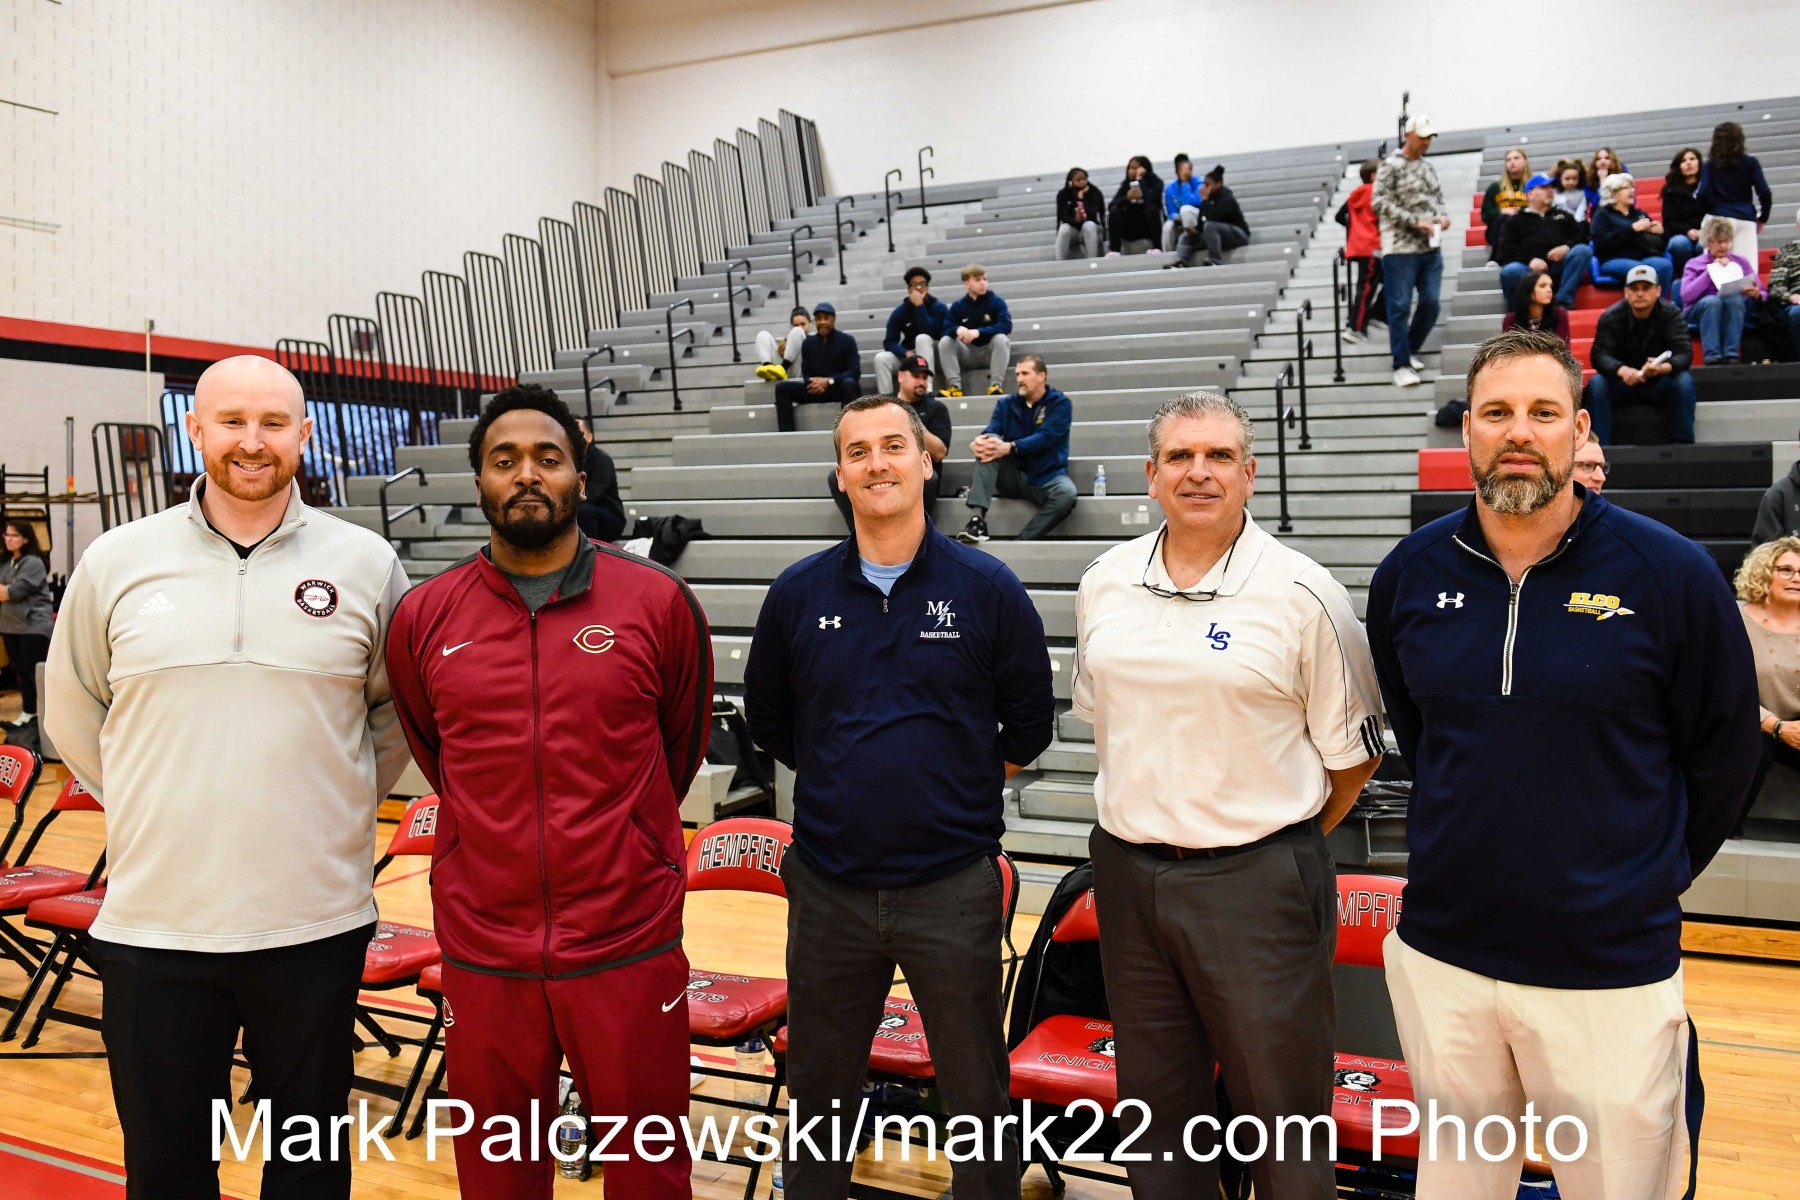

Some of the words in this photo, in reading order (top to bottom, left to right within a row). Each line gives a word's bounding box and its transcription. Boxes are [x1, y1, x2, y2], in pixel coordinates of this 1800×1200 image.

[300, 581, 334, 594] WARWICK
[296, 598, 336, 616] BASKETBALL
[1569, 592, 1621, 610] ELCO
[138, 604, 175, 616] adidas
[1567, 606, 1602, 615] BASKETBALL
[572, 624, 615, 654] C
[919, 631, 961, 639] BASKETBALL
[1205, 622, 1231, 650] LS
